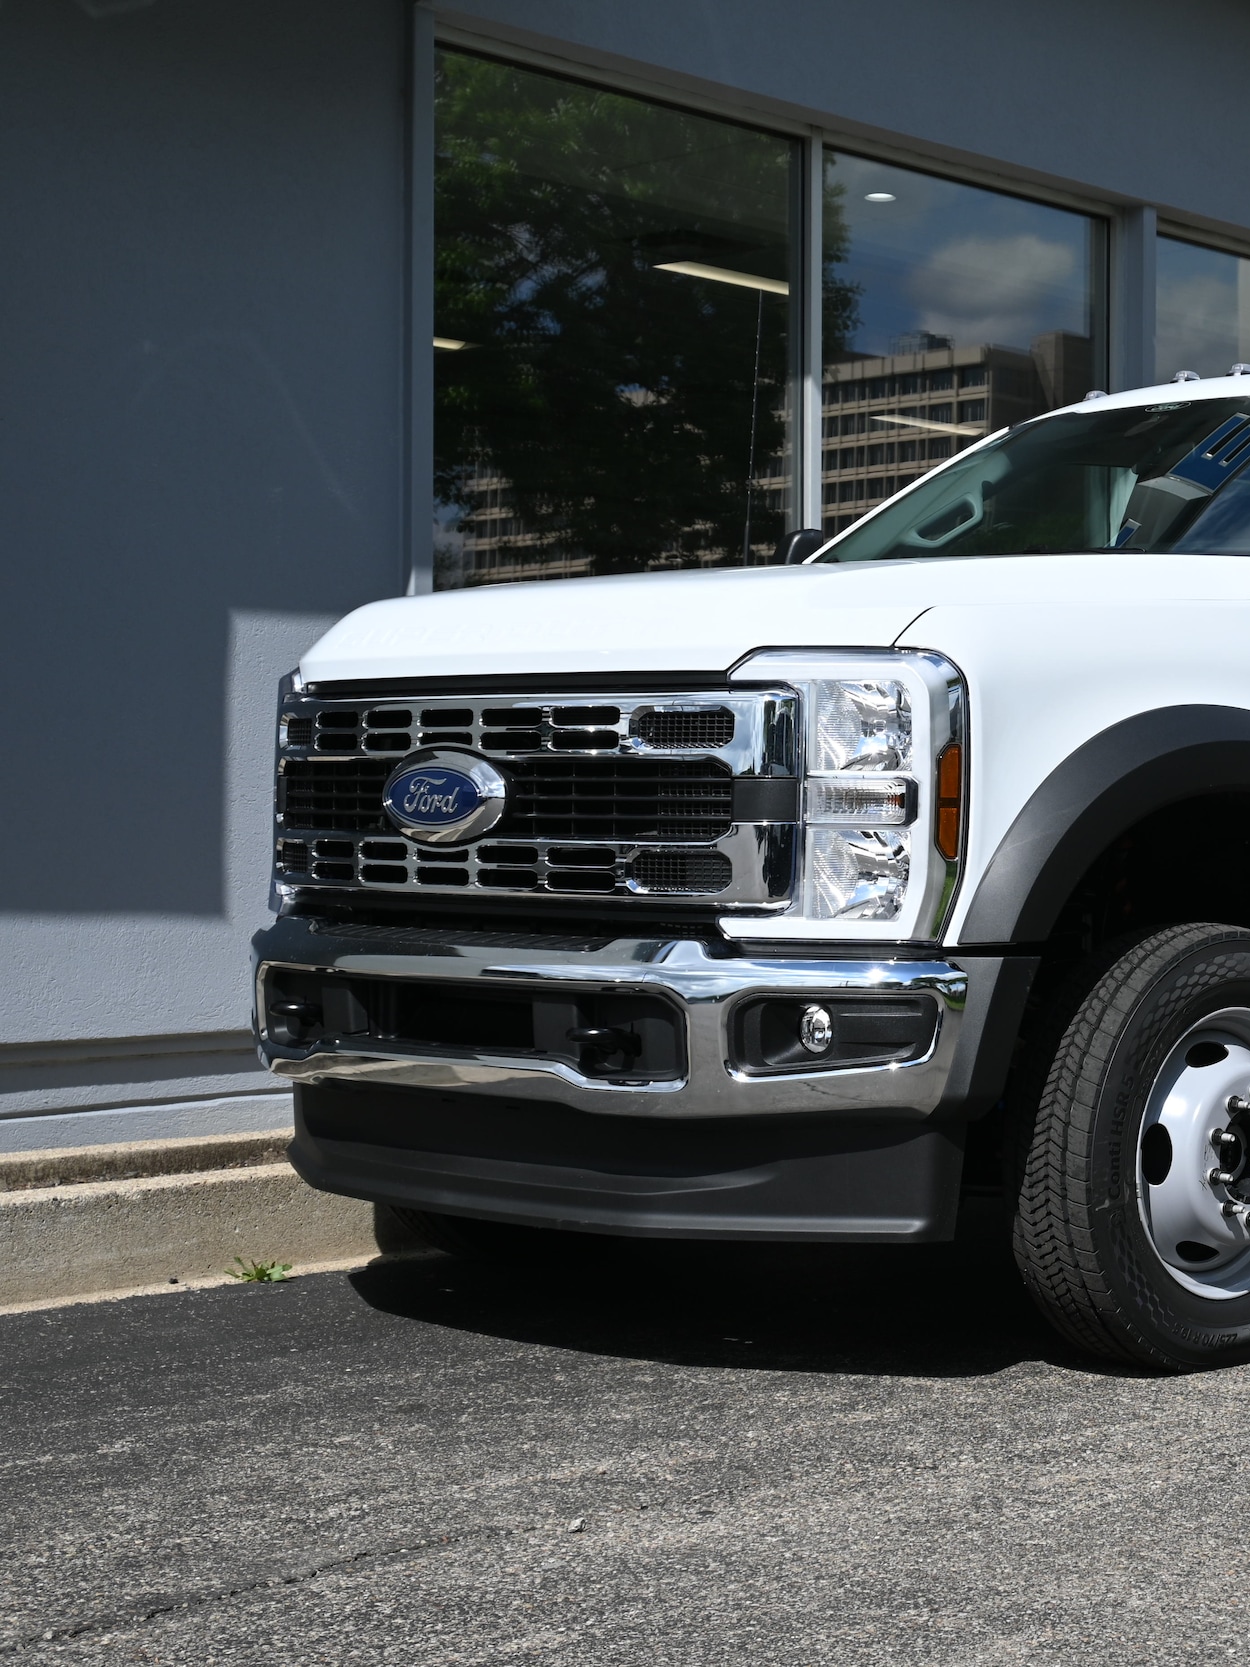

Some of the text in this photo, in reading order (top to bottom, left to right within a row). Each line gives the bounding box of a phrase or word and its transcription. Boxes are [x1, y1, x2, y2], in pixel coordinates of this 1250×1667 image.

[404, 776, 460, 813] Ford
[1106, 1072, 1134, 1201] Conti HSR 5
